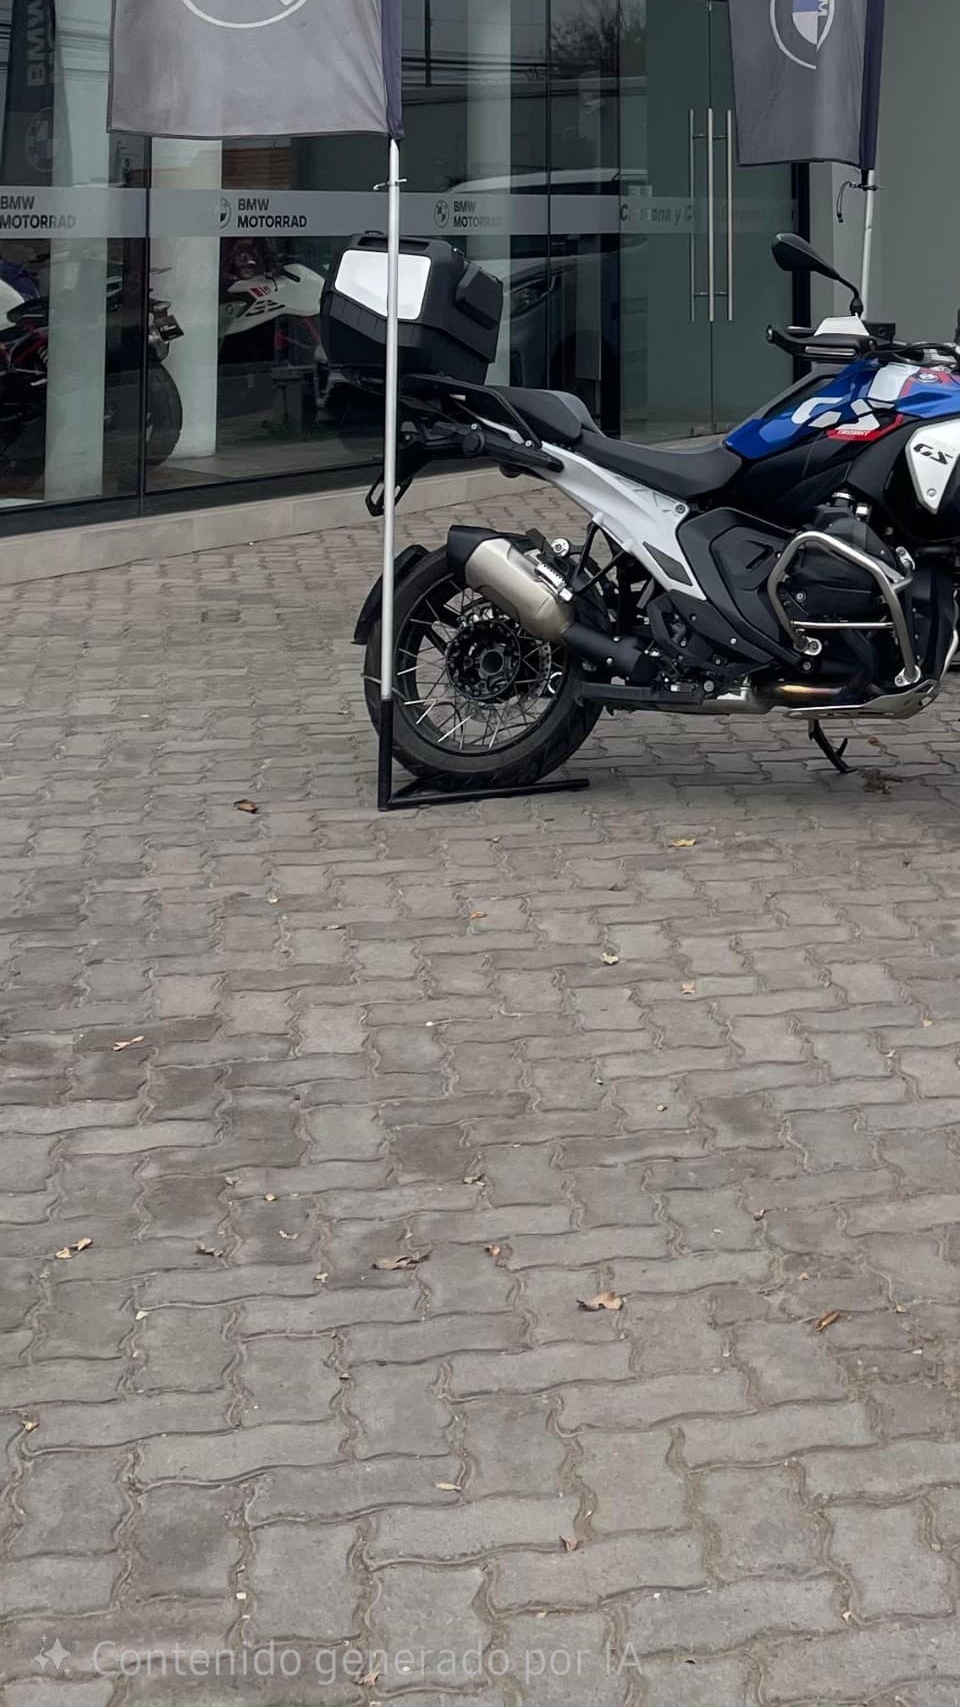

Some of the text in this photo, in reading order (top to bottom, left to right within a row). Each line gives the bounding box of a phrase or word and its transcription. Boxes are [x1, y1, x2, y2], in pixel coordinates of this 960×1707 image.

[0, 195, 35, 210] BMW
[238, 198, 270, 211] BMW
[453, 200, 476, 212] BMW
[0, 214, 76, 229] MOTORRAD
[237, 215, 308, 228] MOTORRAD
